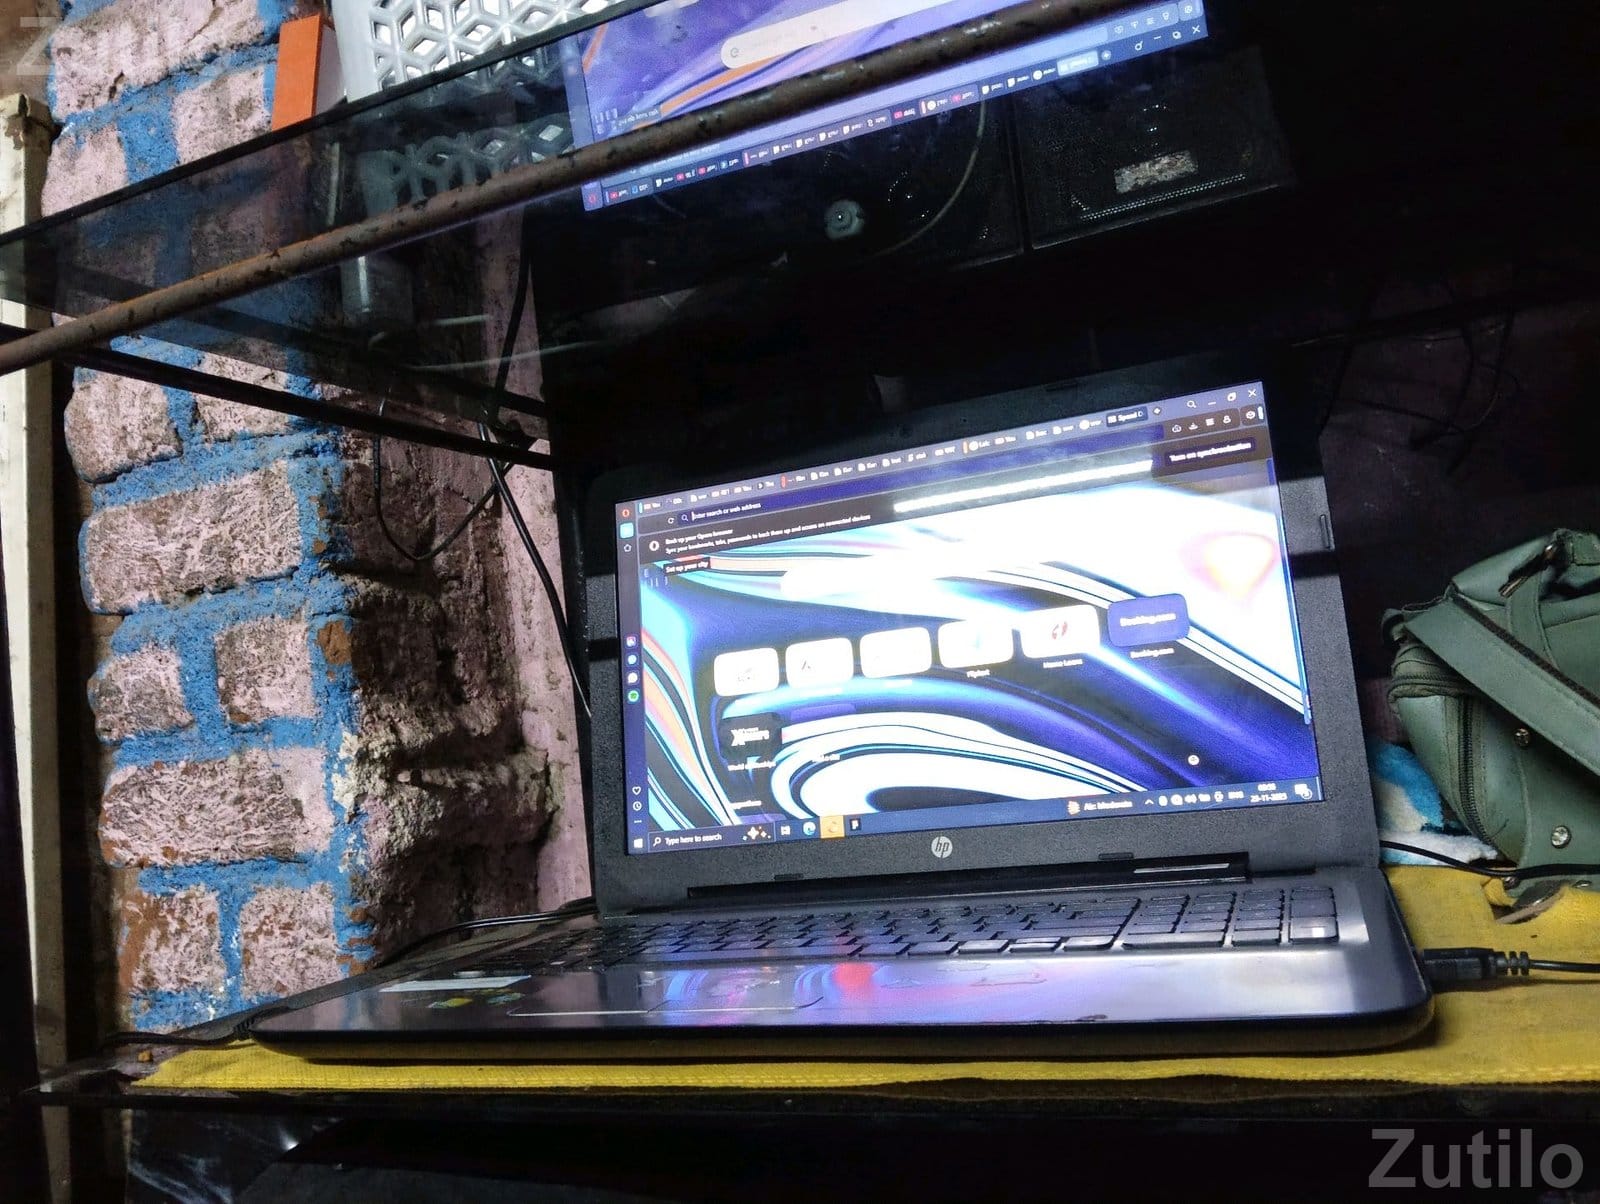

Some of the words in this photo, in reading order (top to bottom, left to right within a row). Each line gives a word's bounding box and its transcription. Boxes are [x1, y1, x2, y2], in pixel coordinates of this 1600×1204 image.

[664, 836, 680, 846] Type
[680, 836, 694, 844] here
[702, 833, 722, 842] search
[932, 836, 952, 858] hp
